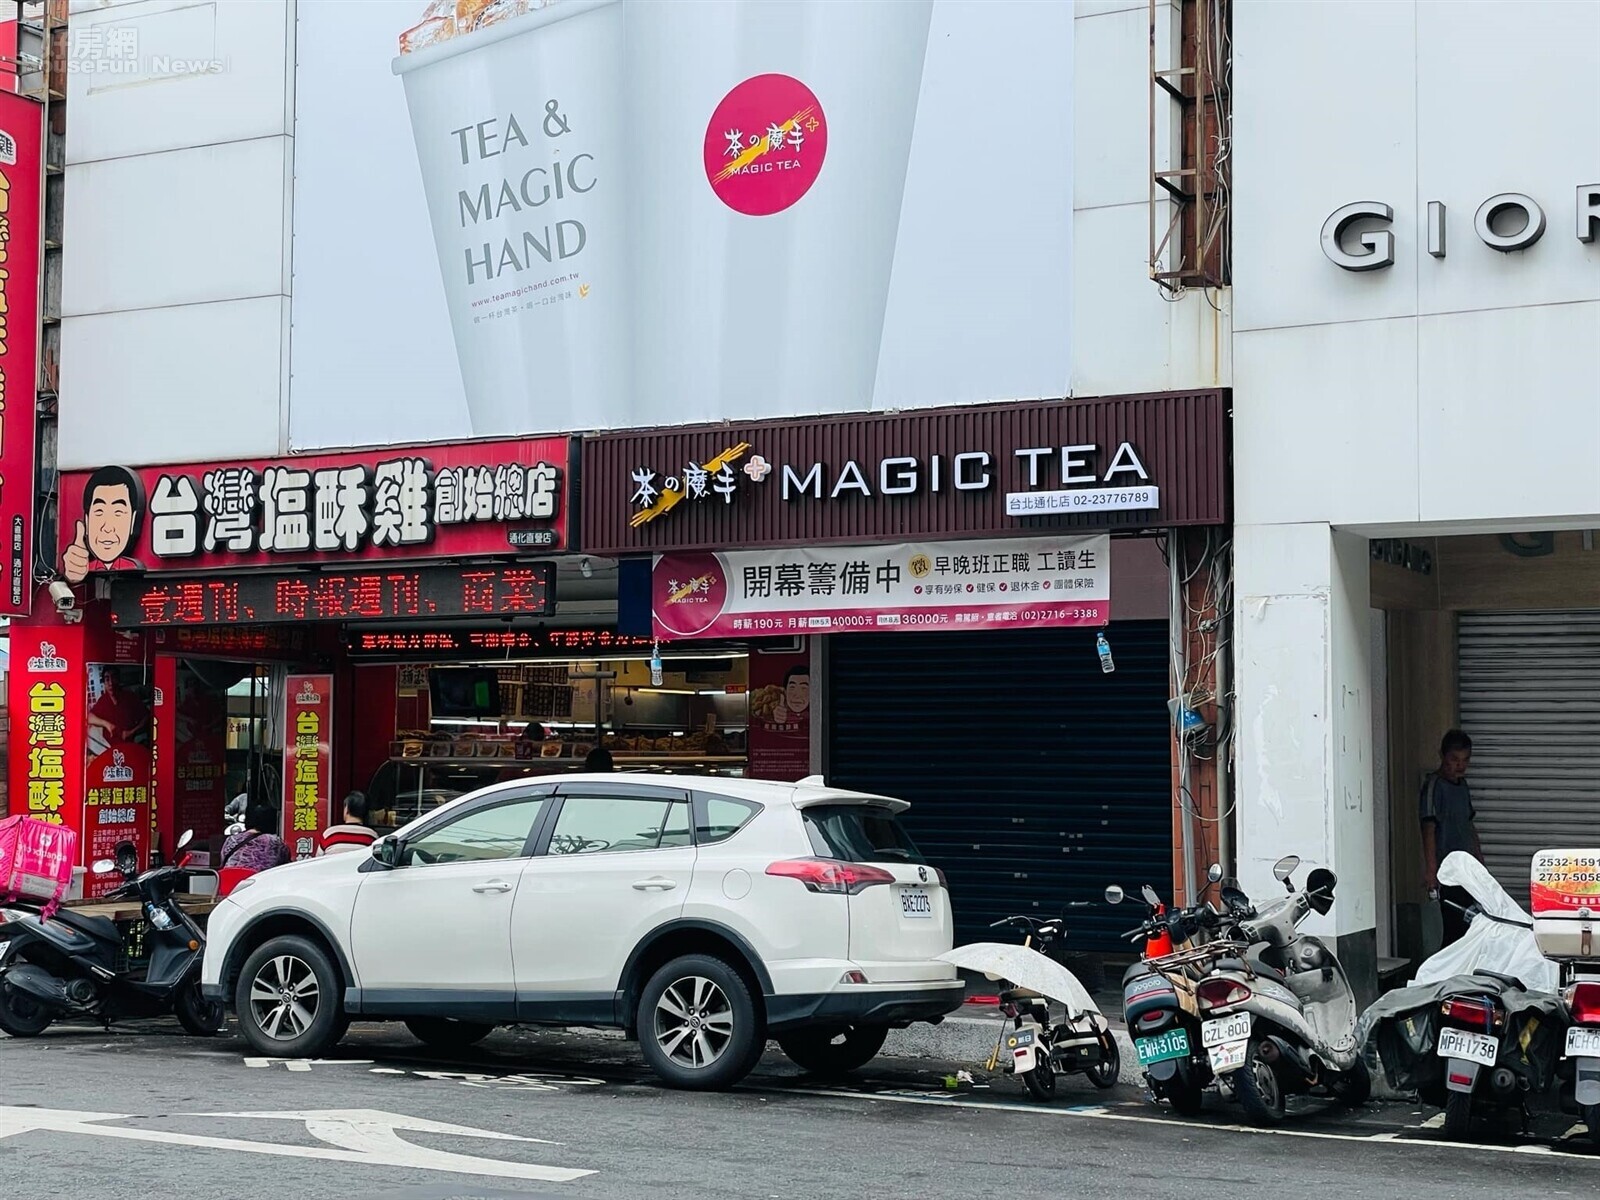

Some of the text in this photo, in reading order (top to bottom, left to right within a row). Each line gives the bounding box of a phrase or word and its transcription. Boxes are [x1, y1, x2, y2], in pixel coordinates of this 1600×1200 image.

[450, 98, 571, 165] TEA &
[731, 159, 801, 175] MAGIC TEA
[458, 153, 598, 228] MAGIC
[1319, 183, 1600, 272] GIOR
[464, 219, 588, 285] HAND
[471, 272, 580, 308] www.teamagichand.com.tw
[781, 442, 1149, 501] MAGIC TEA
[435, 463, 557, 524] 創始總店
[1009, 491, 1150, 511] 台北通化店 02-23776789
[934, 553, 1031, 577] 早晚班正職
[1037, 549, 1097, 571] 工讀生
[743, 559, 901, 599] 開幕籌備中
[976, 582, 996, 593] 健保
[1010, 581, 1040, 592] 退休金
[902, 613, 949, 625] 36000元
[1020, 609, 1098, 622] (02)2716-3388
[1539, 858, 1600, 866] 2532-1591
[1539, 873, 1600, 881] 2737-5058
[1132, 979, 1161, 993] gogoro
[1203, 1021, 1249, 1043] CZL-800
[1440, 1034, 1496, 1059] MPH-1738
